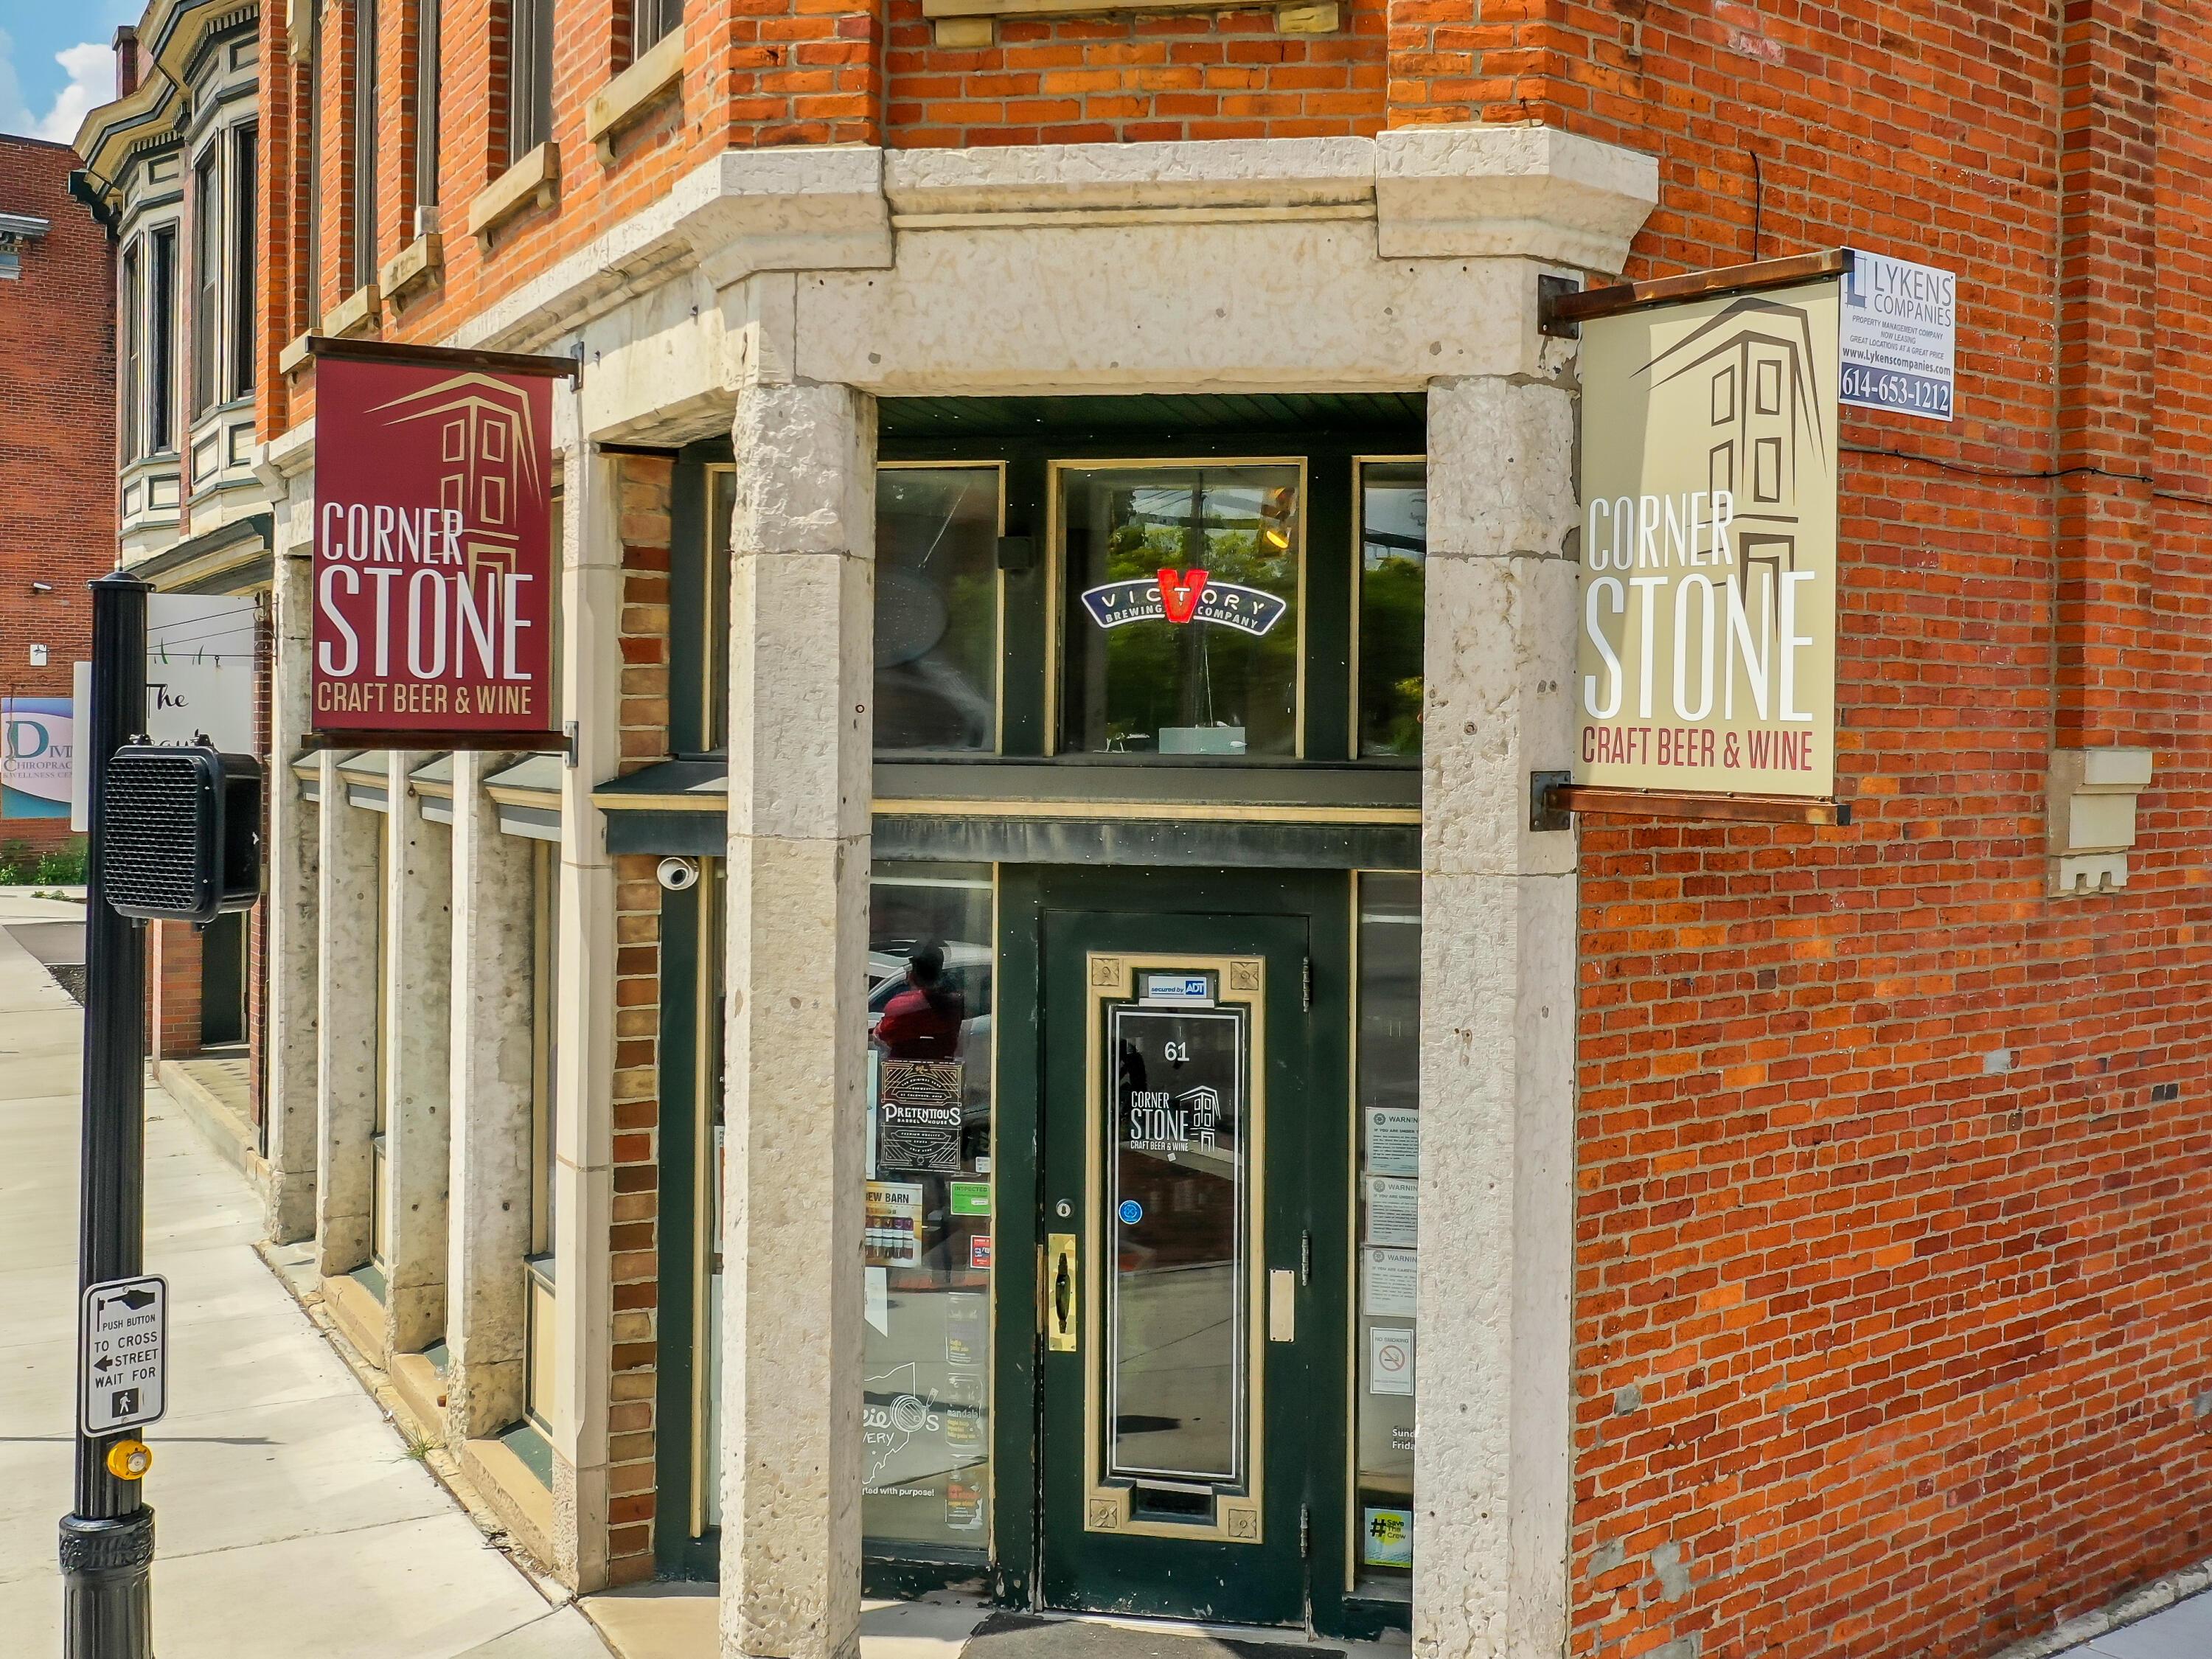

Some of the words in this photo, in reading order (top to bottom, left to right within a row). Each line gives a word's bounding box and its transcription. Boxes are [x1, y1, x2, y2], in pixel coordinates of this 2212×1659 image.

[1874, 261, 1952, 306] LYKENS
[1874, 293, 1952, 327] COMPANIES
[1852, 315, 1880, 327] PROPERTY
[1882, 321, 1917, 334] MANAGEMENT
[1919, 329, 1943, 341] COMPANY
[1880, 331, 1893, 339] NOW
[1894, 333, 1916, 344] LEASING
[1850, 335, 1868, 345] GREAT
[1869, 339, 1898, 350] LOCATIONS
[1911, 347, 1928, 357] GREAT
[1929, 350, 1944, 360] PRICE
[1843, 347, 1951, 376] www.Lykenscompanies.com
[1843, 367, 1949, 411] 614-653-1212
[321, 501, 464, 566] CORNER
[1589, 490, 1733, 571] CORNER
[1102, 587, 1265, 615] VICTORY
[318, 564, 534, 680] STONE
[1105, 604, 1163, 623] BREWING
[1197, 605, 1259, 629] COMPANY
[1583, 571, 1815, 722] STONE
[146, 684, 189, 719] The
[318, 681, 388, 712] CRAFT
[394, 684, 448, 714] BEER
[455, 686, 470, 714] &
[476, 686, 532, 715] WINE
[1582, 726, 1650, 765] CRAFT
[1658, 728, 1715, 768] BEER
[1723, 731, 1740, 769] &
[1747, 730, 1813, 771] WINE
[1186, 982, 1204, 993] ADT
[1164, 1041, 1189, 1062] 61
[1131, 1091, 1169, 1109] CORNER
[881, 1103, 961, 1126] PRETENTIOUS
[1130, 1107, 1189, 1142] STONE
[1130, 1141, 1150, 1150] CRAFT
[1150, 1141, 1166, 1150] BEER
[1166, 1142, 1171, 1150] &
[1172, 1142, 1189, 1152] WINE
[885, 1193, 909, 1204] BARN
[102, 1318, 123, 1332] PUSH
[127, 1314, 156, 1328] BUTTON
[94, 1340, 109, 1353] TO
[118, 1331, 158, 1349] CROSS
[115, 1348, 159, 1367] STREET
[95, 1372, 124, 1389] WAIT
[132, 1366, 156, 1382] FOR
[900, 1488, 935, 1498] purpose!
[1387, 1519, 1405, 1527] Save
